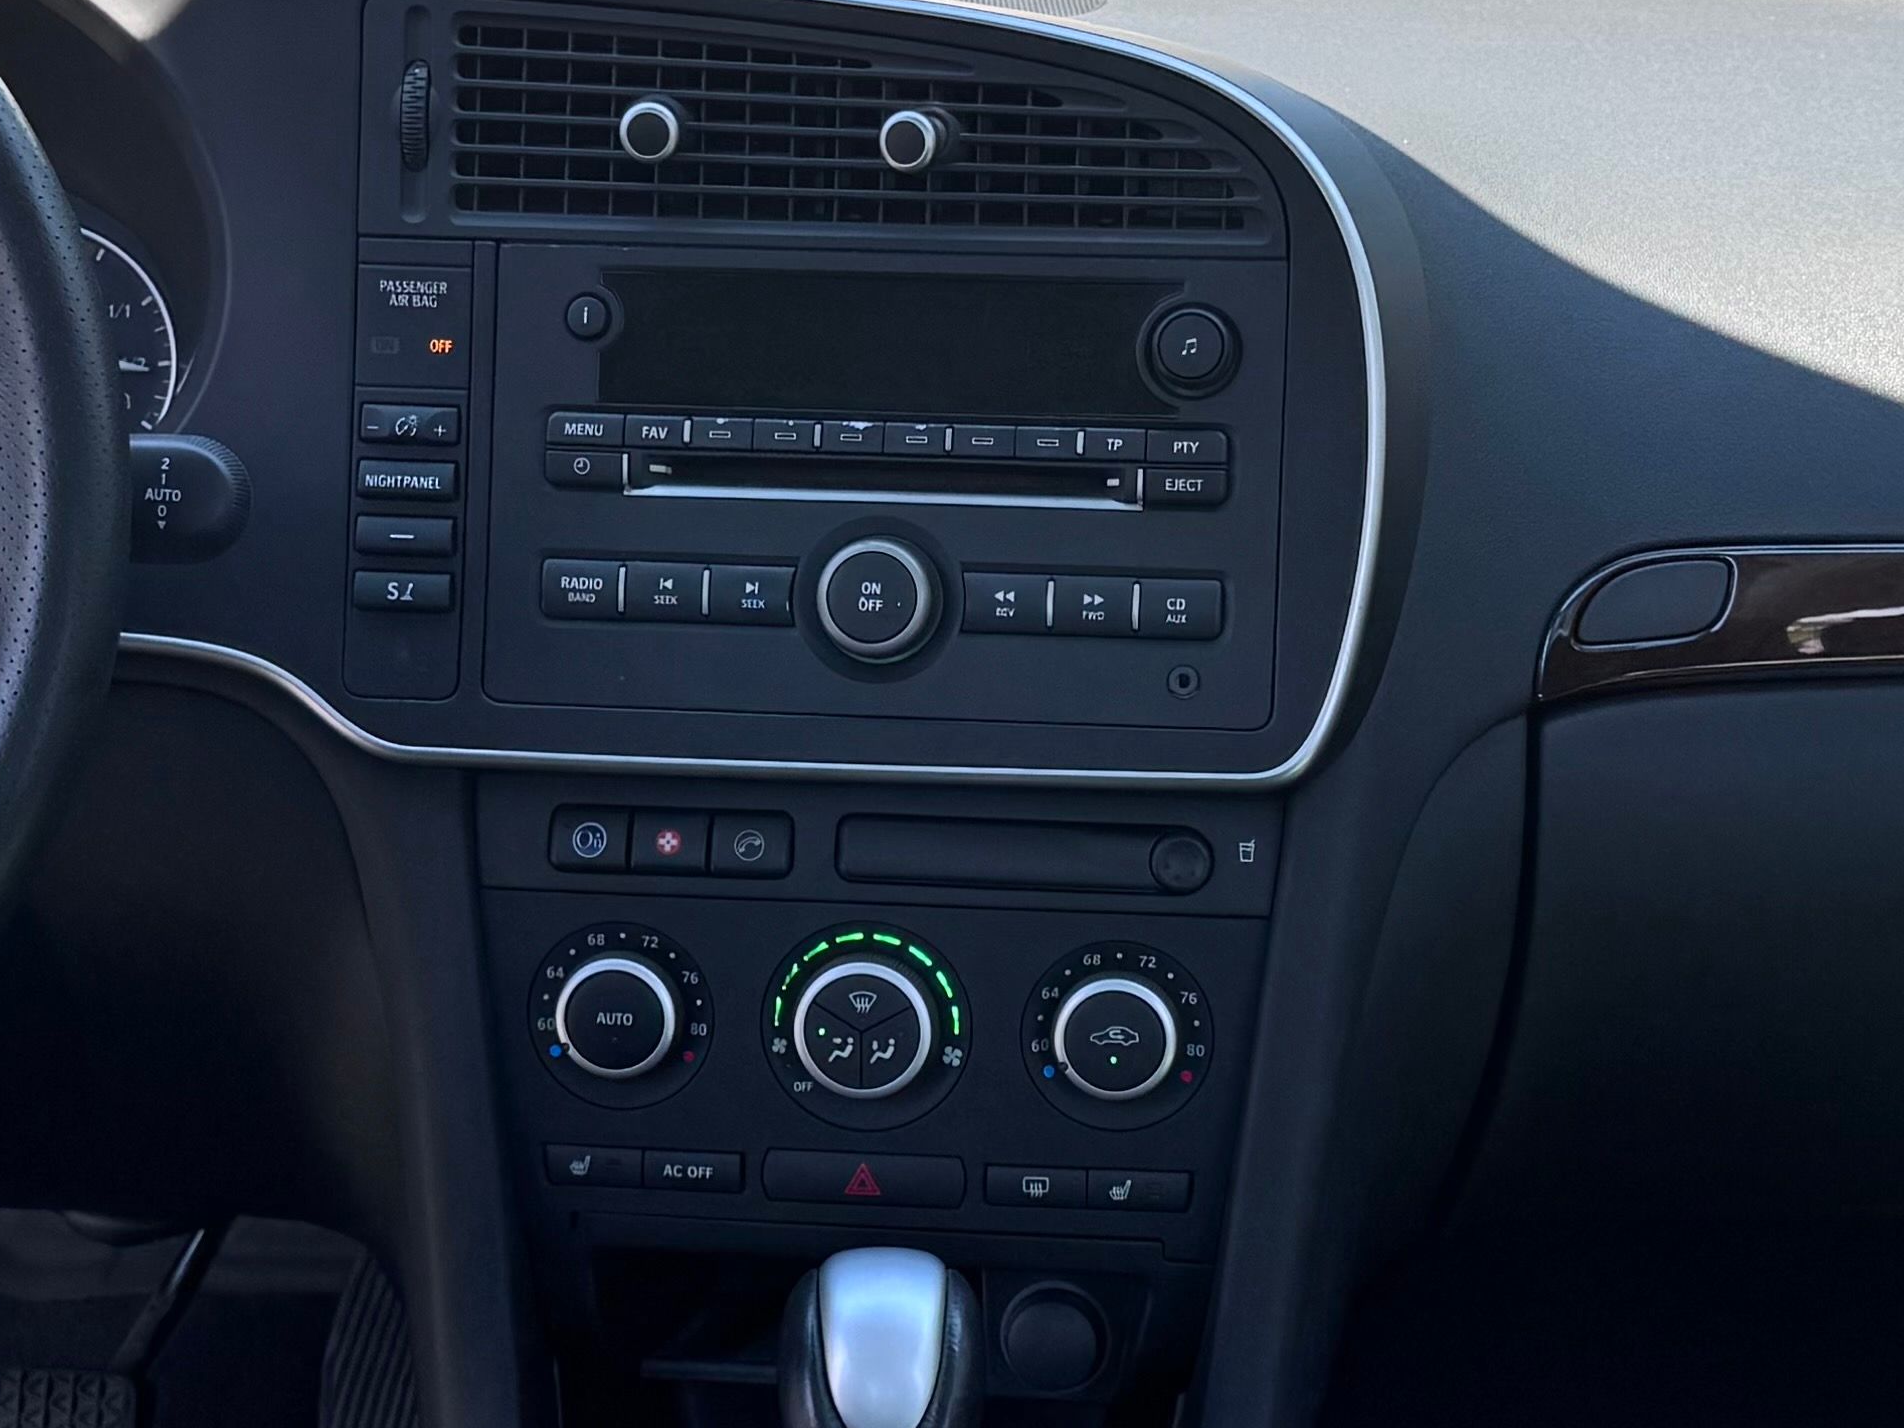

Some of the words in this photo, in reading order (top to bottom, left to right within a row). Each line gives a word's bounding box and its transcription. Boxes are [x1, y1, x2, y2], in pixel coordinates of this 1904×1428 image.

[380, 279, 447, 295] PASSENGER
[389, 293, 409, 307] AIR
[412, 294, 438, 309] BAG
[108, 303, 131, 320] 1/1
[429, 339, 453, 354] OFF
[564, 422, 604, 438] MENU
[642, 426, 669, 440] FAV
[1106, 438, 1124, 451] TP
[1173, 441, 1200, 455] PTY
[160, 457, 170, 470] 2
[161, 473, 167, 486] 1
[364, 473, 442, 491] NIGHTPANEL
[1165, 478, 1205, 492] EJECT
[145, 488, 182, 503] AUTO
[560, 576, 603, 591] RADIO
[861, 580, 882, 596] ON
[858, 598, 885, 613] OFF
[1166, 597, 1187, 612] CD
[587, 933, 605, 946] 68
[641, 935, 659, 949] 72
[1083, 953, 1101, 966] 68
[1139, 955, 1157, 969] 72
[546, 966, 564, 979] 64
[681, 971, 699, 985] 76
[1041, 987, 1059, 1000] 64
[1179, 991, 1198, 1005] 76
[537, 1018, 557, 1031] 60
[596, 1012, 634, 1027] AUTO
[690, 1023, 708, 1037] 80
[1031, 1039, 1049, 1052] 60
[1186, 1044, 1206, 1057] 80
[793, 1081, 814, 1093] OFF
[662, 1164, 683, 1178] AC
[687, 1165, 714, 1180] OFF
